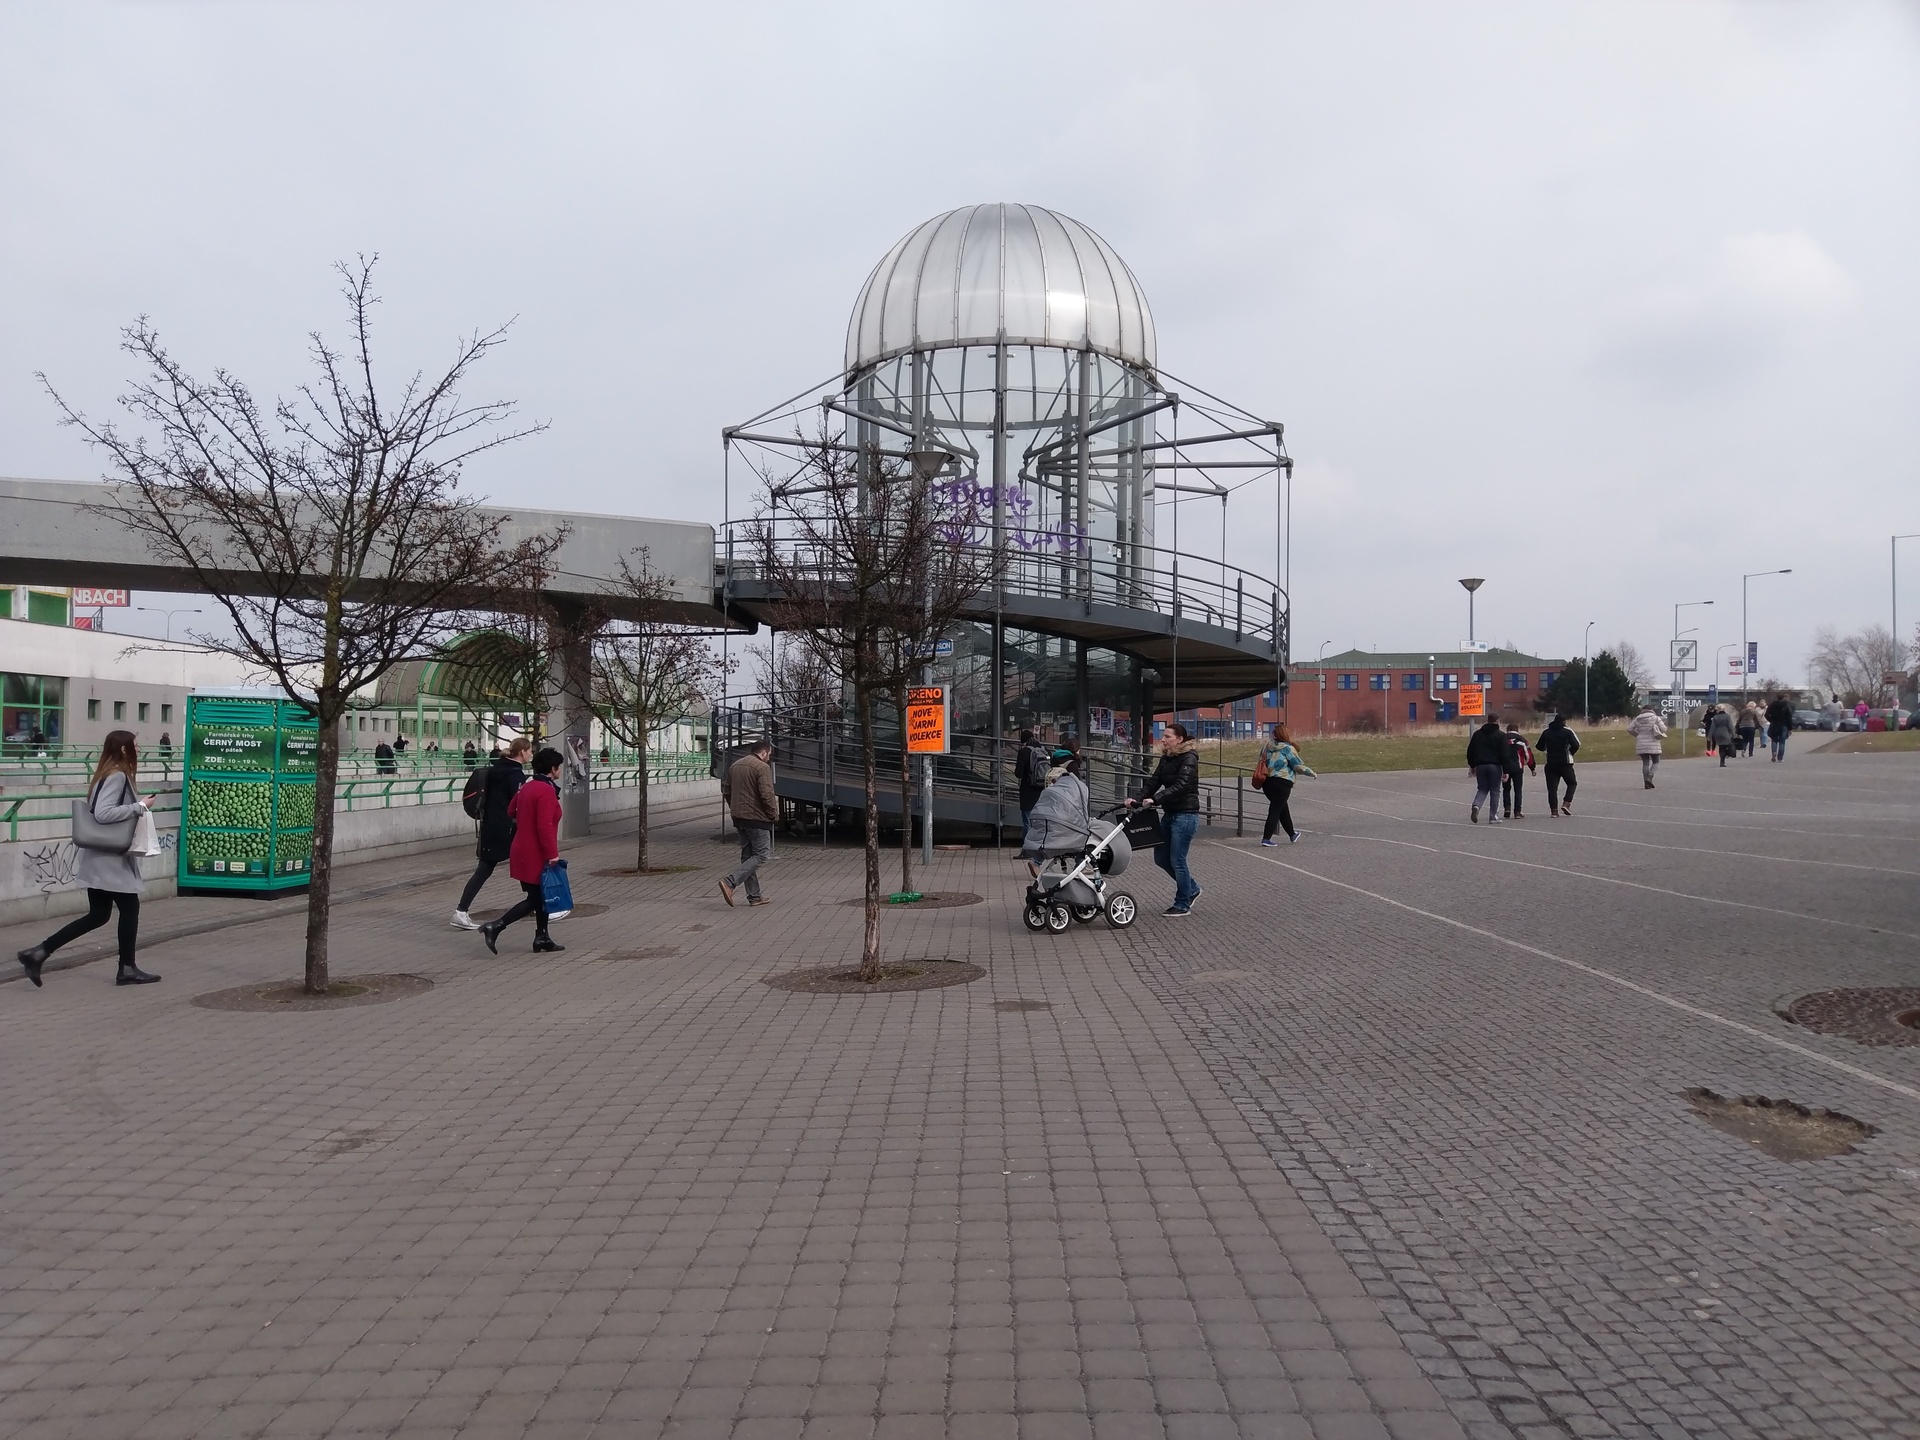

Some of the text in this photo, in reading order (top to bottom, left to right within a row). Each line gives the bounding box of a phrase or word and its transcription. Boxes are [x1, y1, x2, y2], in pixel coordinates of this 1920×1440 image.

[1661, 699, 1702, 707] CERUM
[909, 730, 942, 742] KOLEKCE
[203, 738, 233, 746] ČERNÝ
[286, 741, 305, 749] ČERNÝ
